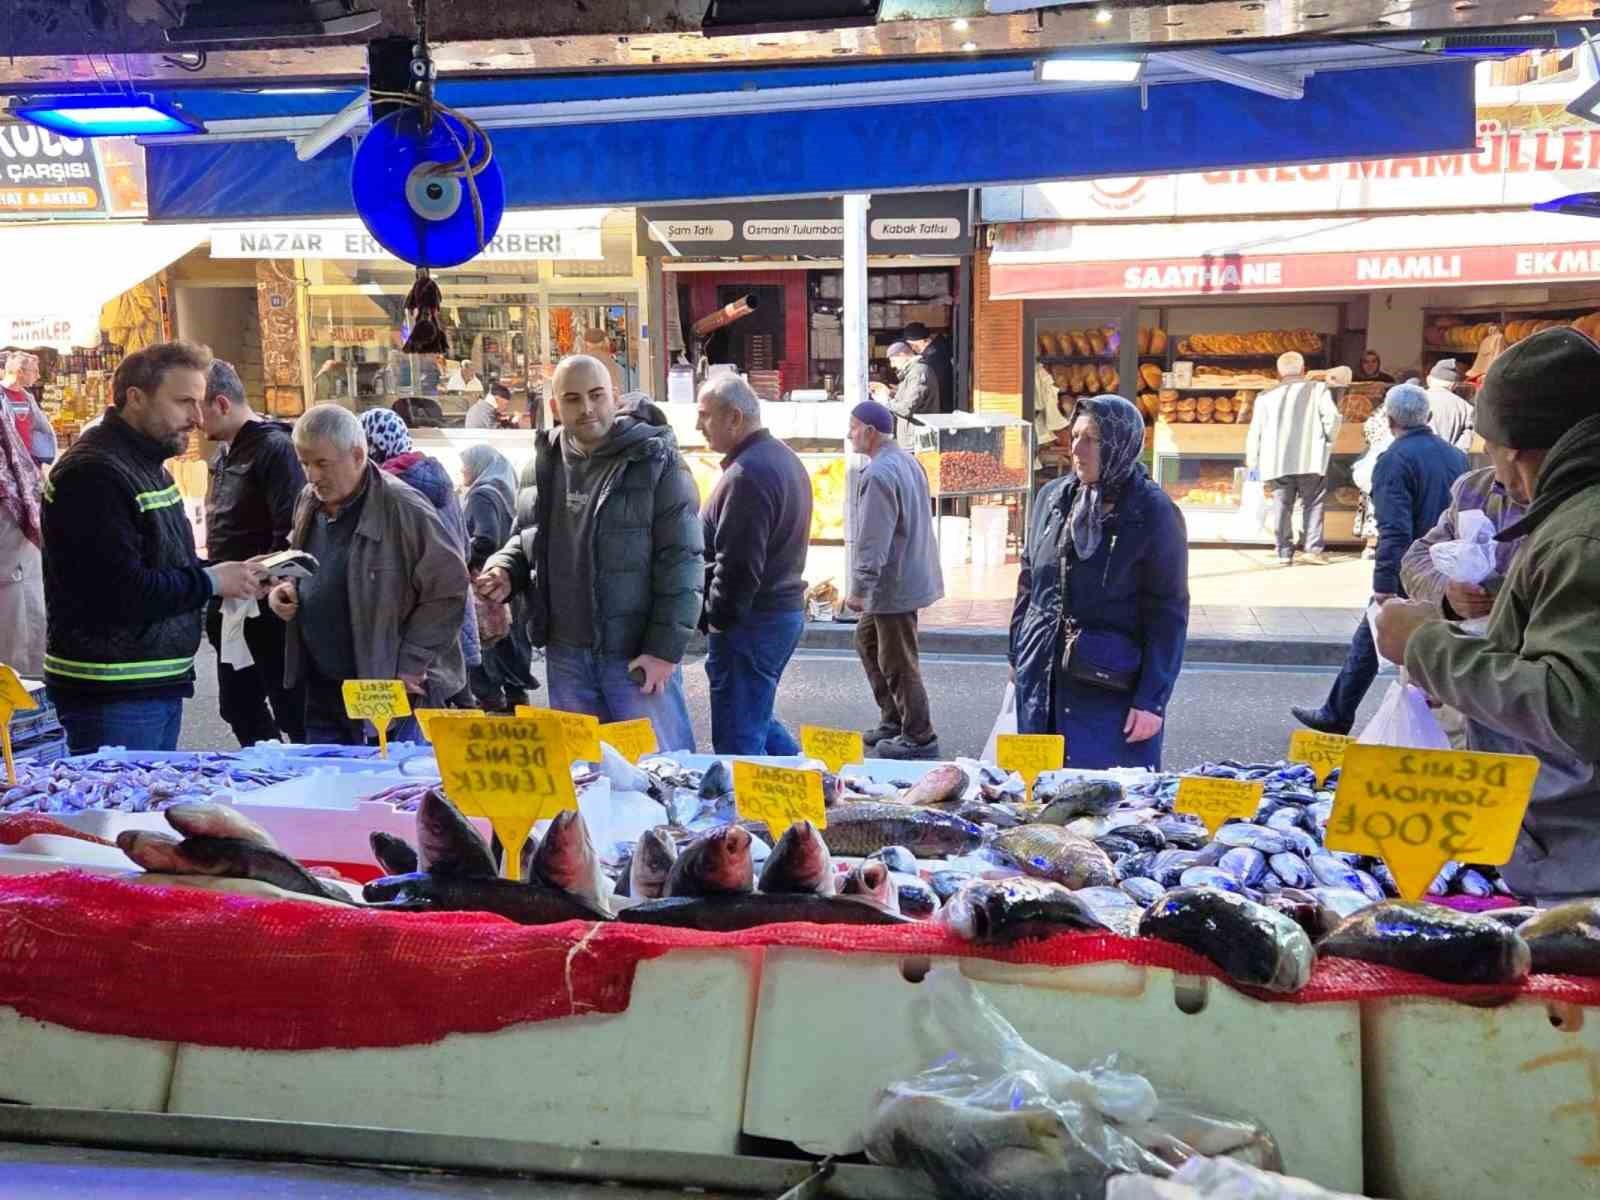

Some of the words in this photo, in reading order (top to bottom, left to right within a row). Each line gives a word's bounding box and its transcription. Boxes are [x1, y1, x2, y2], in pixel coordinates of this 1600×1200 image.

[882, 224, 916, 234] Kabak
[240, 234, 323, 253] NAZAR
[1124, 262, 1281, 289] SAATHANE
[1356, 255, 1461, 280] NAMLI
